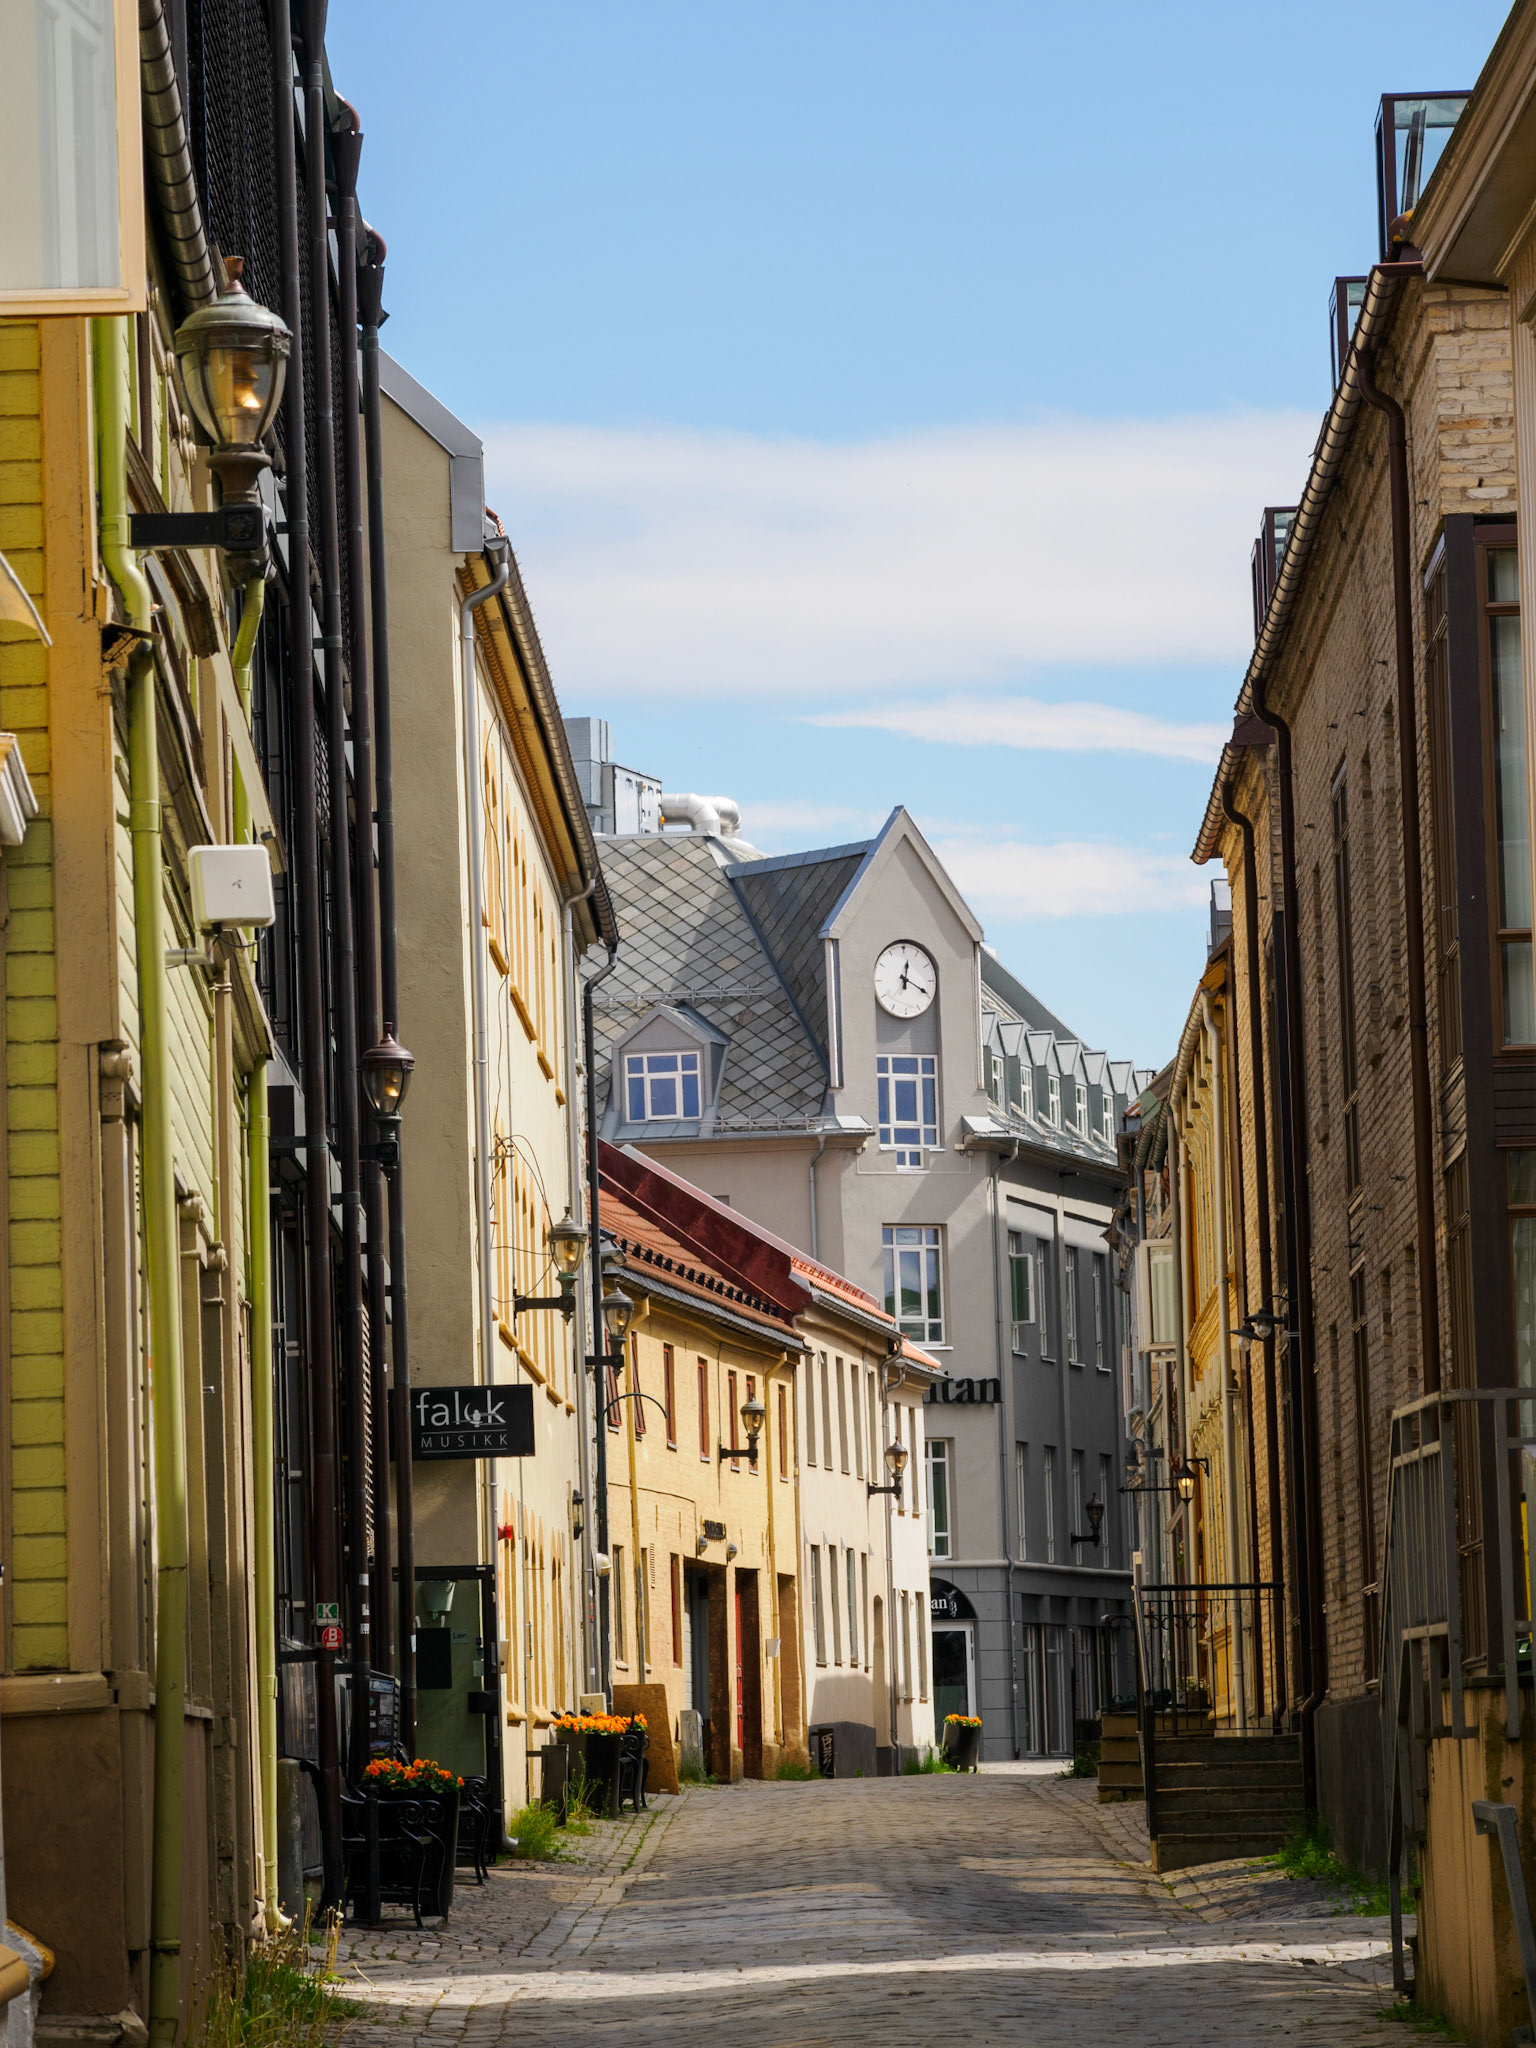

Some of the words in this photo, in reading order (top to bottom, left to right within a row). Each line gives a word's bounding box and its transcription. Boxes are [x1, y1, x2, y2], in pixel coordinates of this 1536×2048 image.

[421, 1434, 508, 1448] MUSIKK
[322, 1603, 333, 1618] K
[328, 1628, 338, 1642] B
